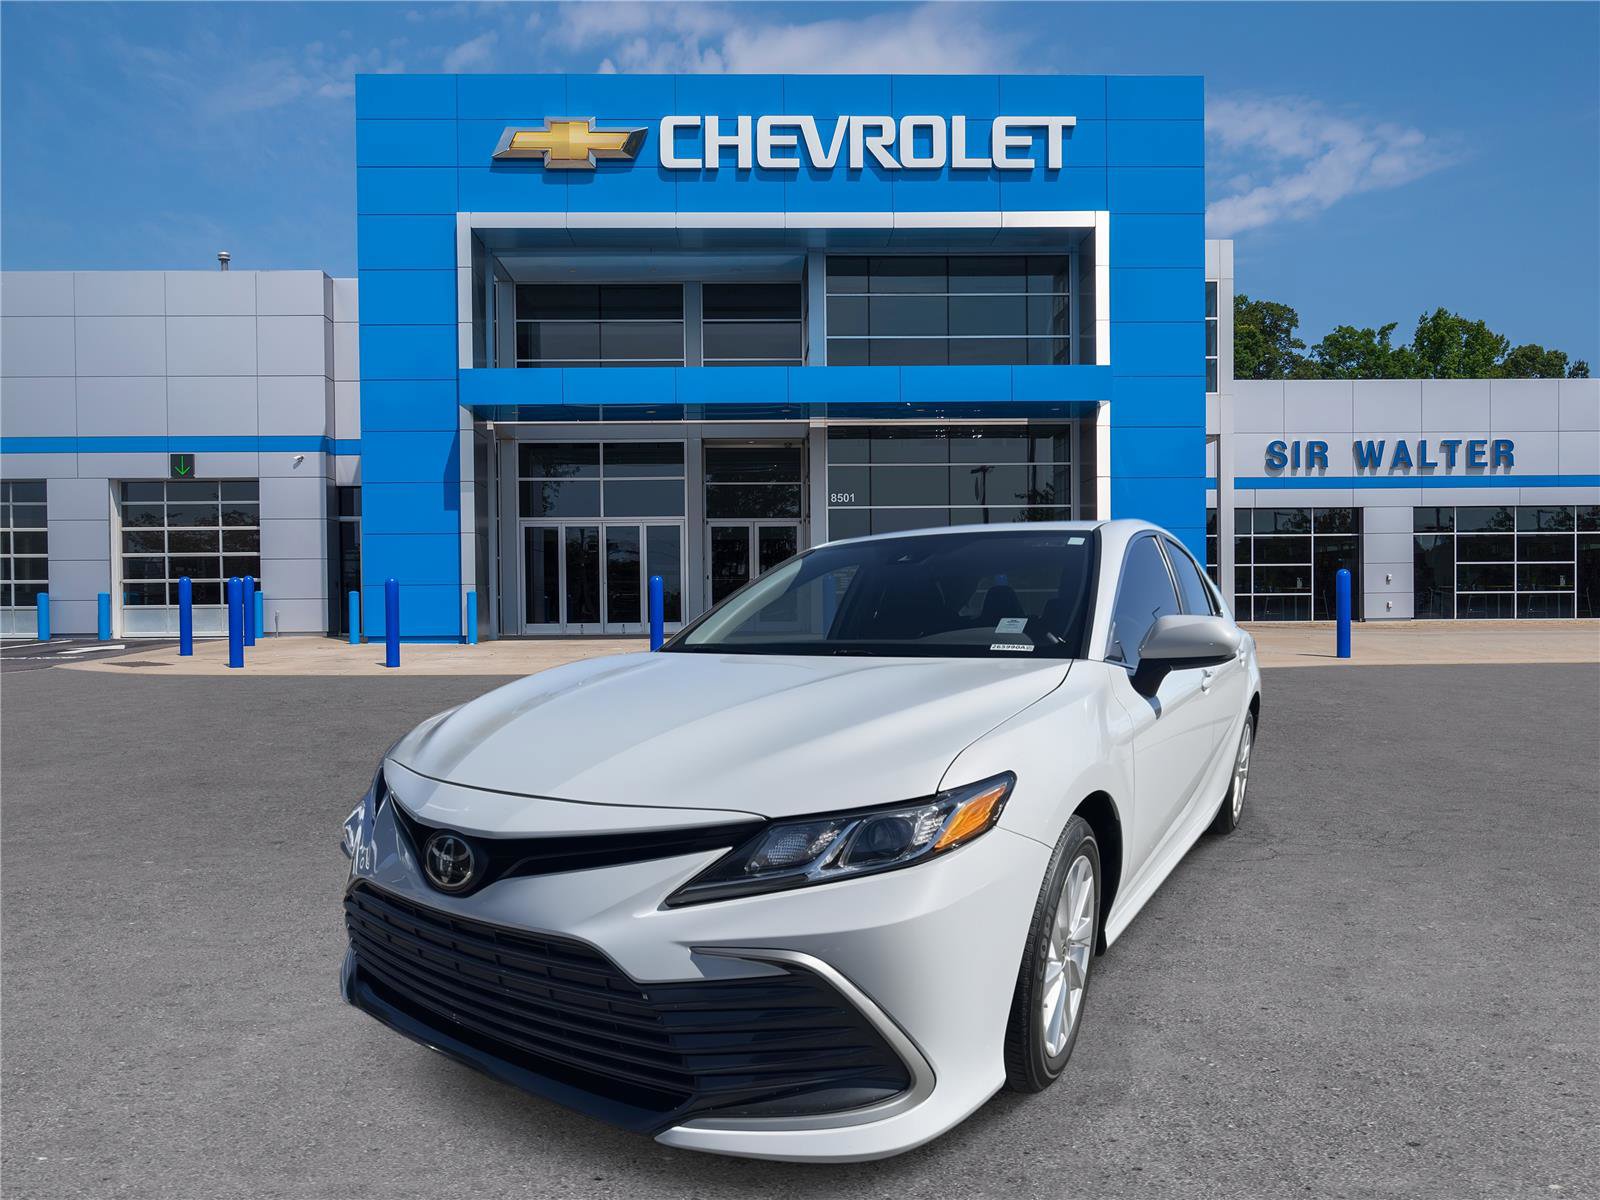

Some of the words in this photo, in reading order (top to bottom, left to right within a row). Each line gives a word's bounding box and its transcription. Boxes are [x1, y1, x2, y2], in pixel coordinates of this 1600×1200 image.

[660, 115, 1076, 169] CHEVROLET
[1266, 440, 1329, 469] SIR
[1354, 439, 1515, 469] WALTER
[830, 493, 855, 503] 8501
